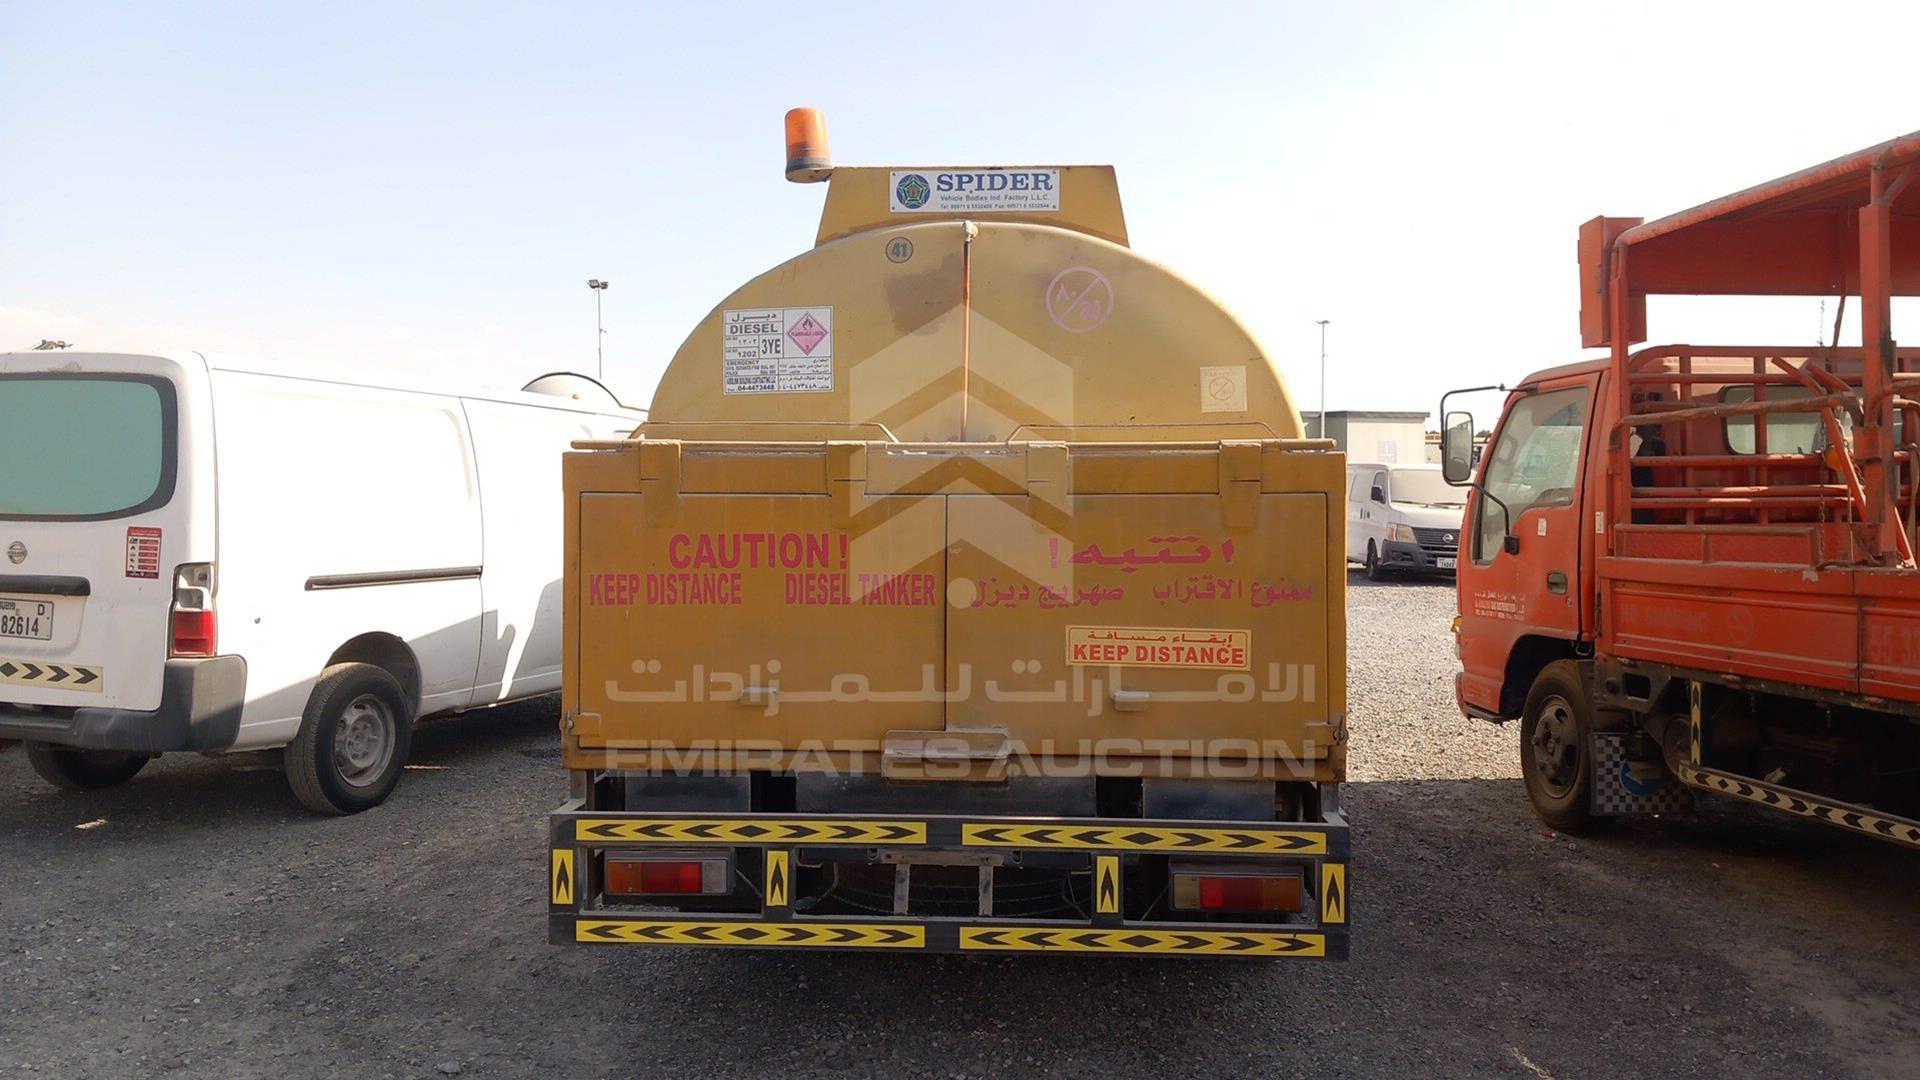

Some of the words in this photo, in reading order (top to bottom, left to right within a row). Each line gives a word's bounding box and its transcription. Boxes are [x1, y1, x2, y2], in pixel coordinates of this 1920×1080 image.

[937, 173, 1053, 192] SPIDER
[732, 312, 777, 323] ديزل
[730, 323, 778, 334] DIESEL
[761, 339, 781, 355] 3YE
[590, 573, 641, 606] KEEP
[646, 573, 742, 606] DISTANCE
[785, 573, 853, 606] DIESEL
[859, 573, 937, 607] TANKER
[969, 577, 1031, 609] ديزل
[1038, 581, 1126, 609] صهريج
[1152, 573, 1243, 606] الاقتراب
[1250, 579, 1314, 609] ممنوع
[37, 604, 46, 616] D
[1, 615, 40, 636] 82614
[1087, 631, 1167, 643] مسافة
[1172, 633, 1233, 648] إبقاء
[1073, 644, 1129, 661] KEEP
[1135, 645, 1244, 664] DISTANCE
